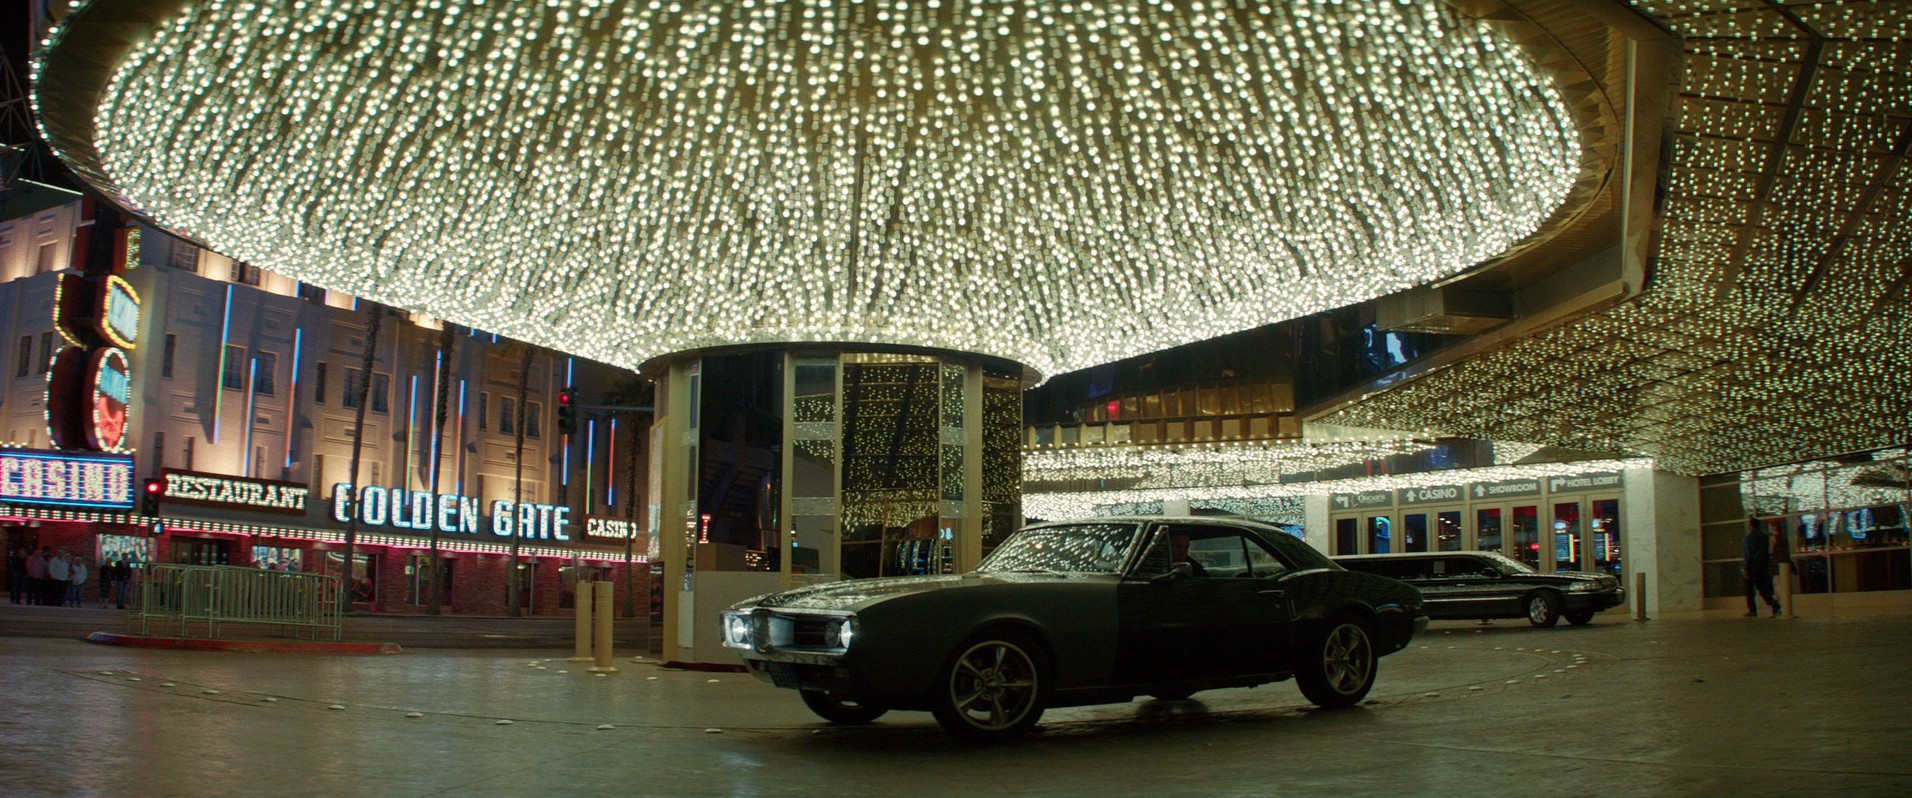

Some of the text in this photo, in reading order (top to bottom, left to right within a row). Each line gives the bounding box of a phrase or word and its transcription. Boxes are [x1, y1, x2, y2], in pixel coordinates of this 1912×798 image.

[0, 457, 129, 503] CASINO
[164, 473, 309, 510] RESTAURANT
[1488, 483, 1537, 495] SHOWROOM
[1567, 476, 1619, 488] HOTEL LOBBY
[1418, 487, 1458, 501] CASINO
[334, 482, 571, 541] GOLDEN GATE
